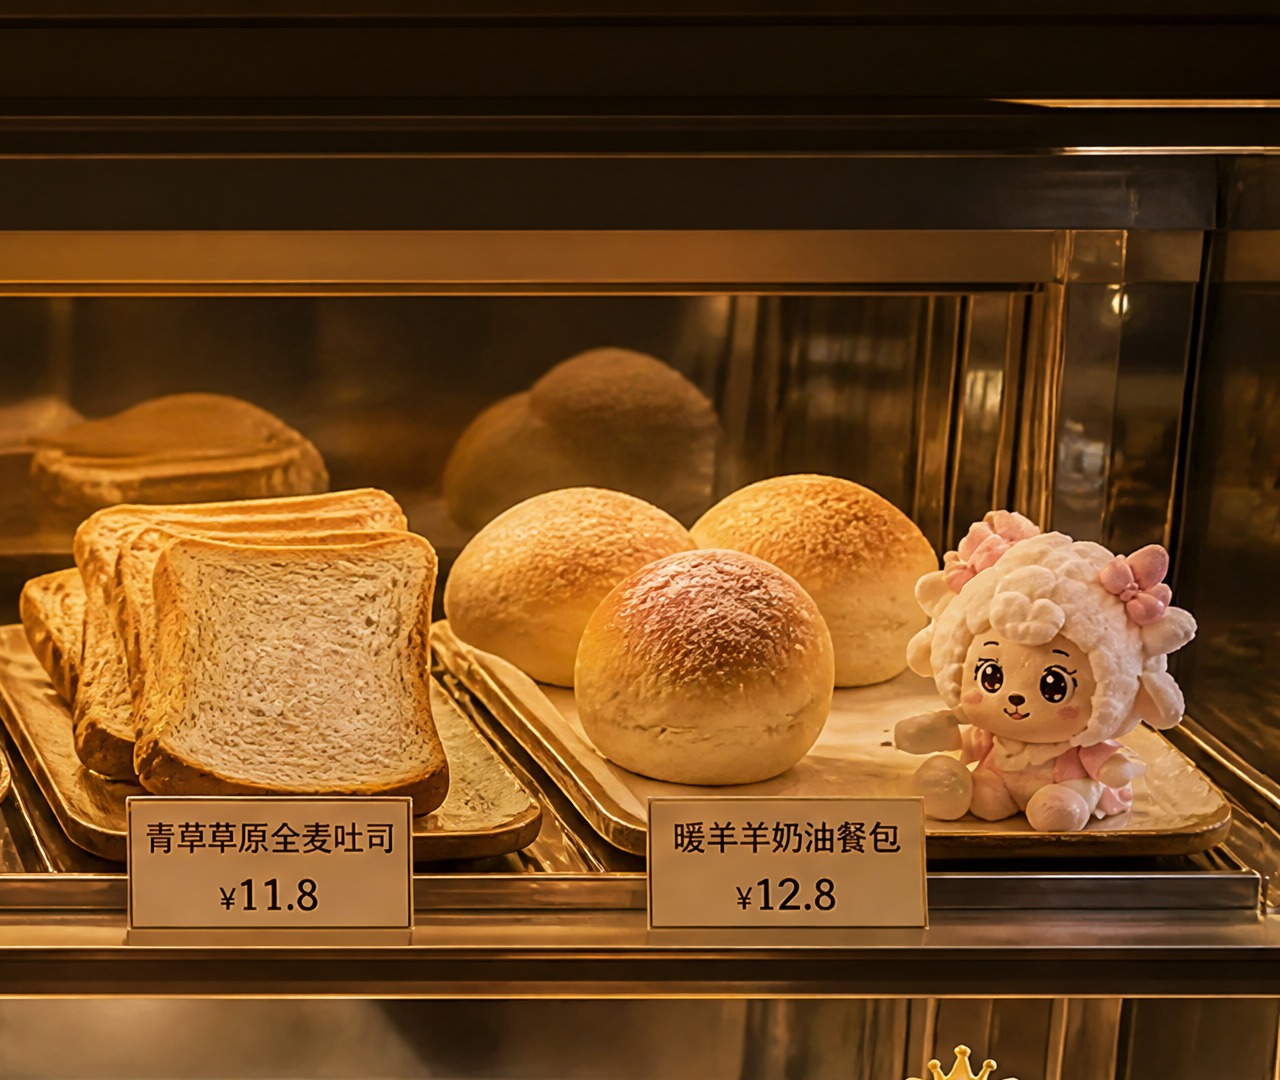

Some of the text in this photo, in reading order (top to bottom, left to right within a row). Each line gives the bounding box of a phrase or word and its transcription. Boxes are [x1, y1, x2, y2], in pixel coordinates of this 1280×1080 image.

[146, 821, 394, 855] 青草草原全麦吐司
[674, 820, 902, 854] 暖羊羊奶油餐包
[219, 878, 318, 912] ¥11.8
[735, 877, 836, 911] ¥12.8
